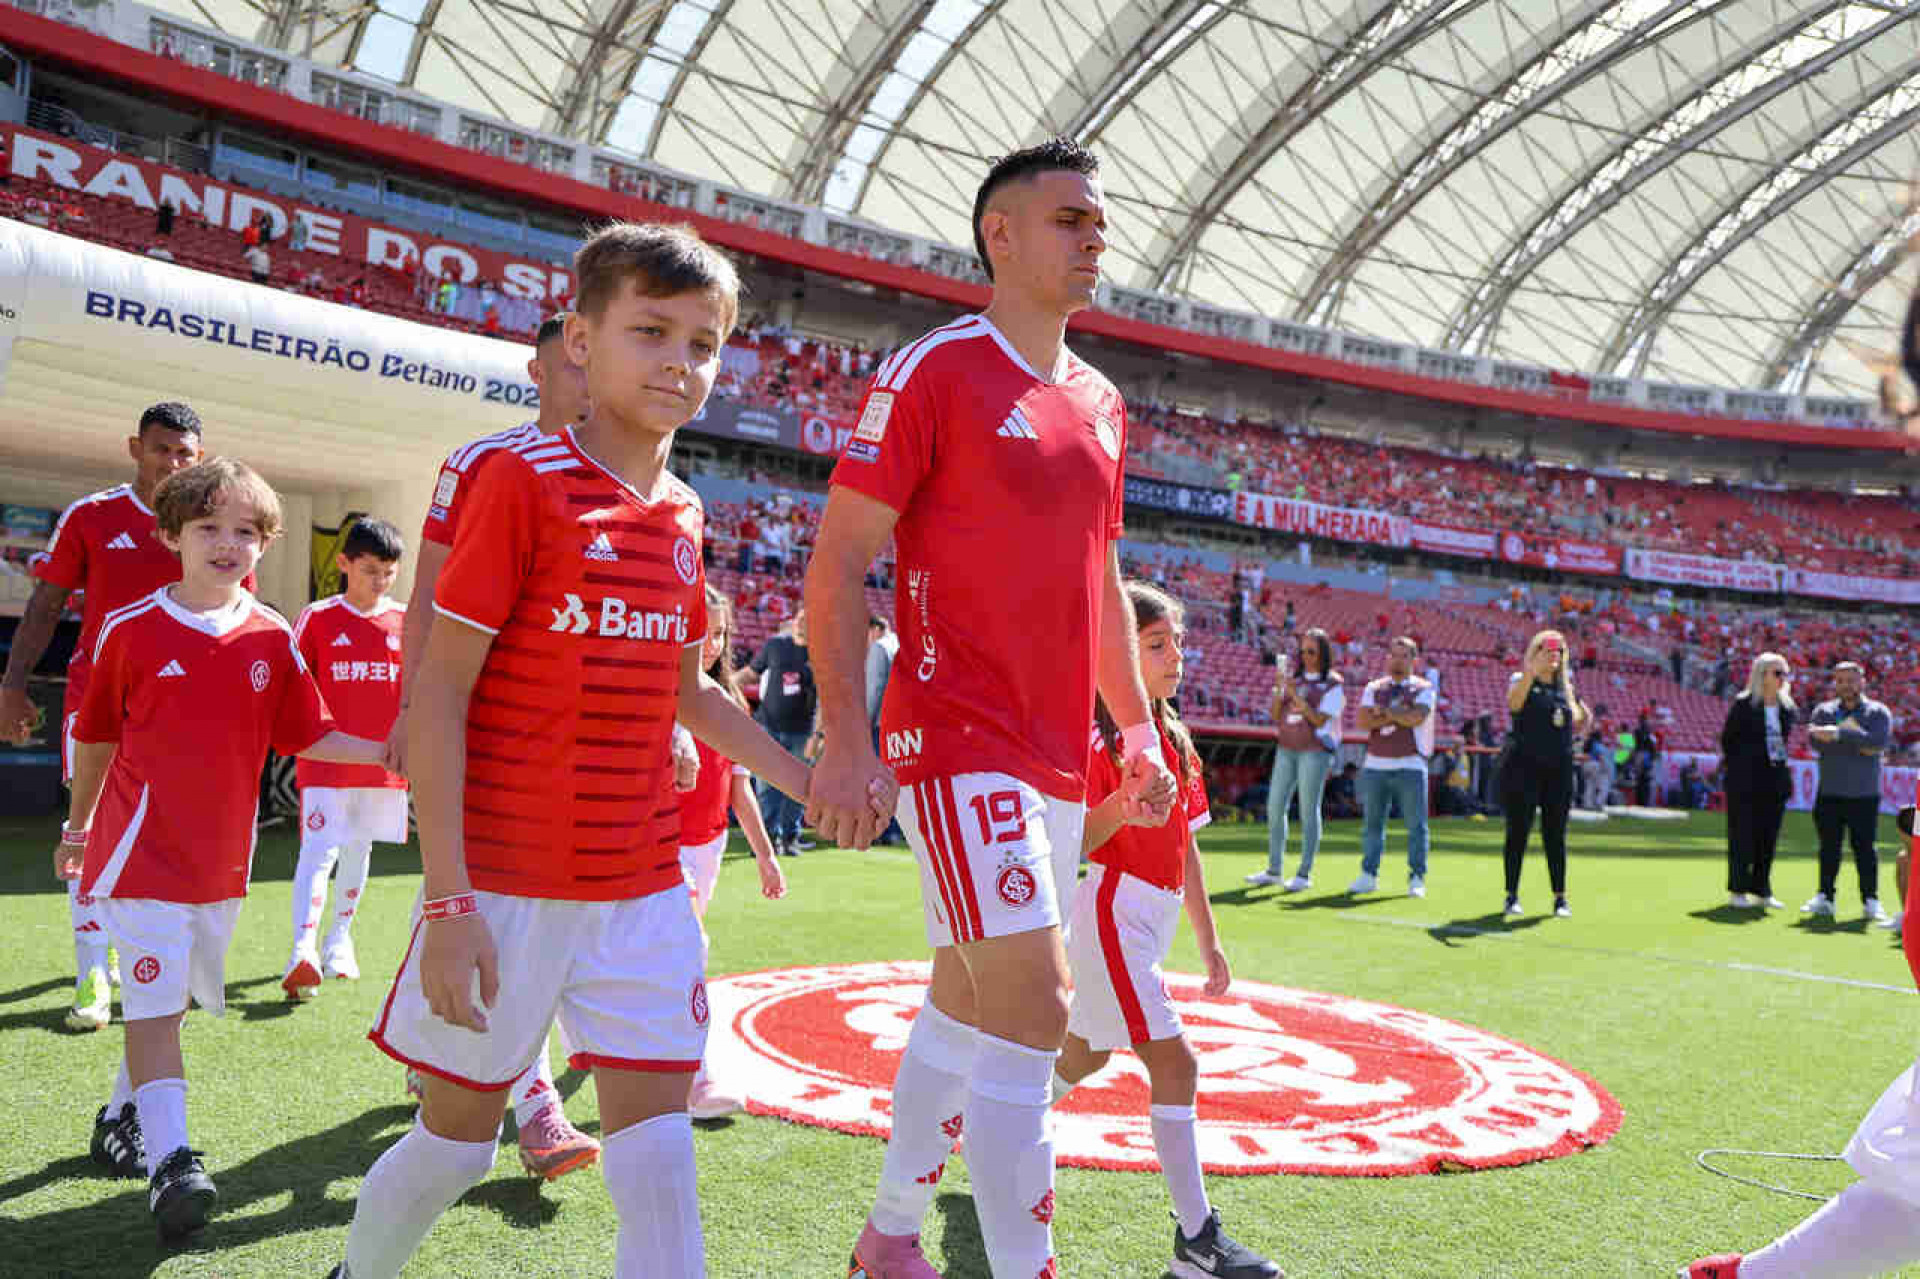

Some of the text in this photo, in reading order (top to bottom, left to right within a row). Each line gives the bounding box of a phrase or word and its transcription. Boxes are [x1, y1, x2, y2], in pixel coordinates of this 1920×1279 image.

[0, 134, 342, 255] RANDE
[367, 227, 479, 284] DO
[85, 290, 540, 408] BRASILEIRÃO Betano 202
[1236, 493, 1247, 524] E
[1254, 499, 1267, 528] A
[1273, 502, 1391, 544] MULHERADA
[969, 790, 1027, 846] 19
